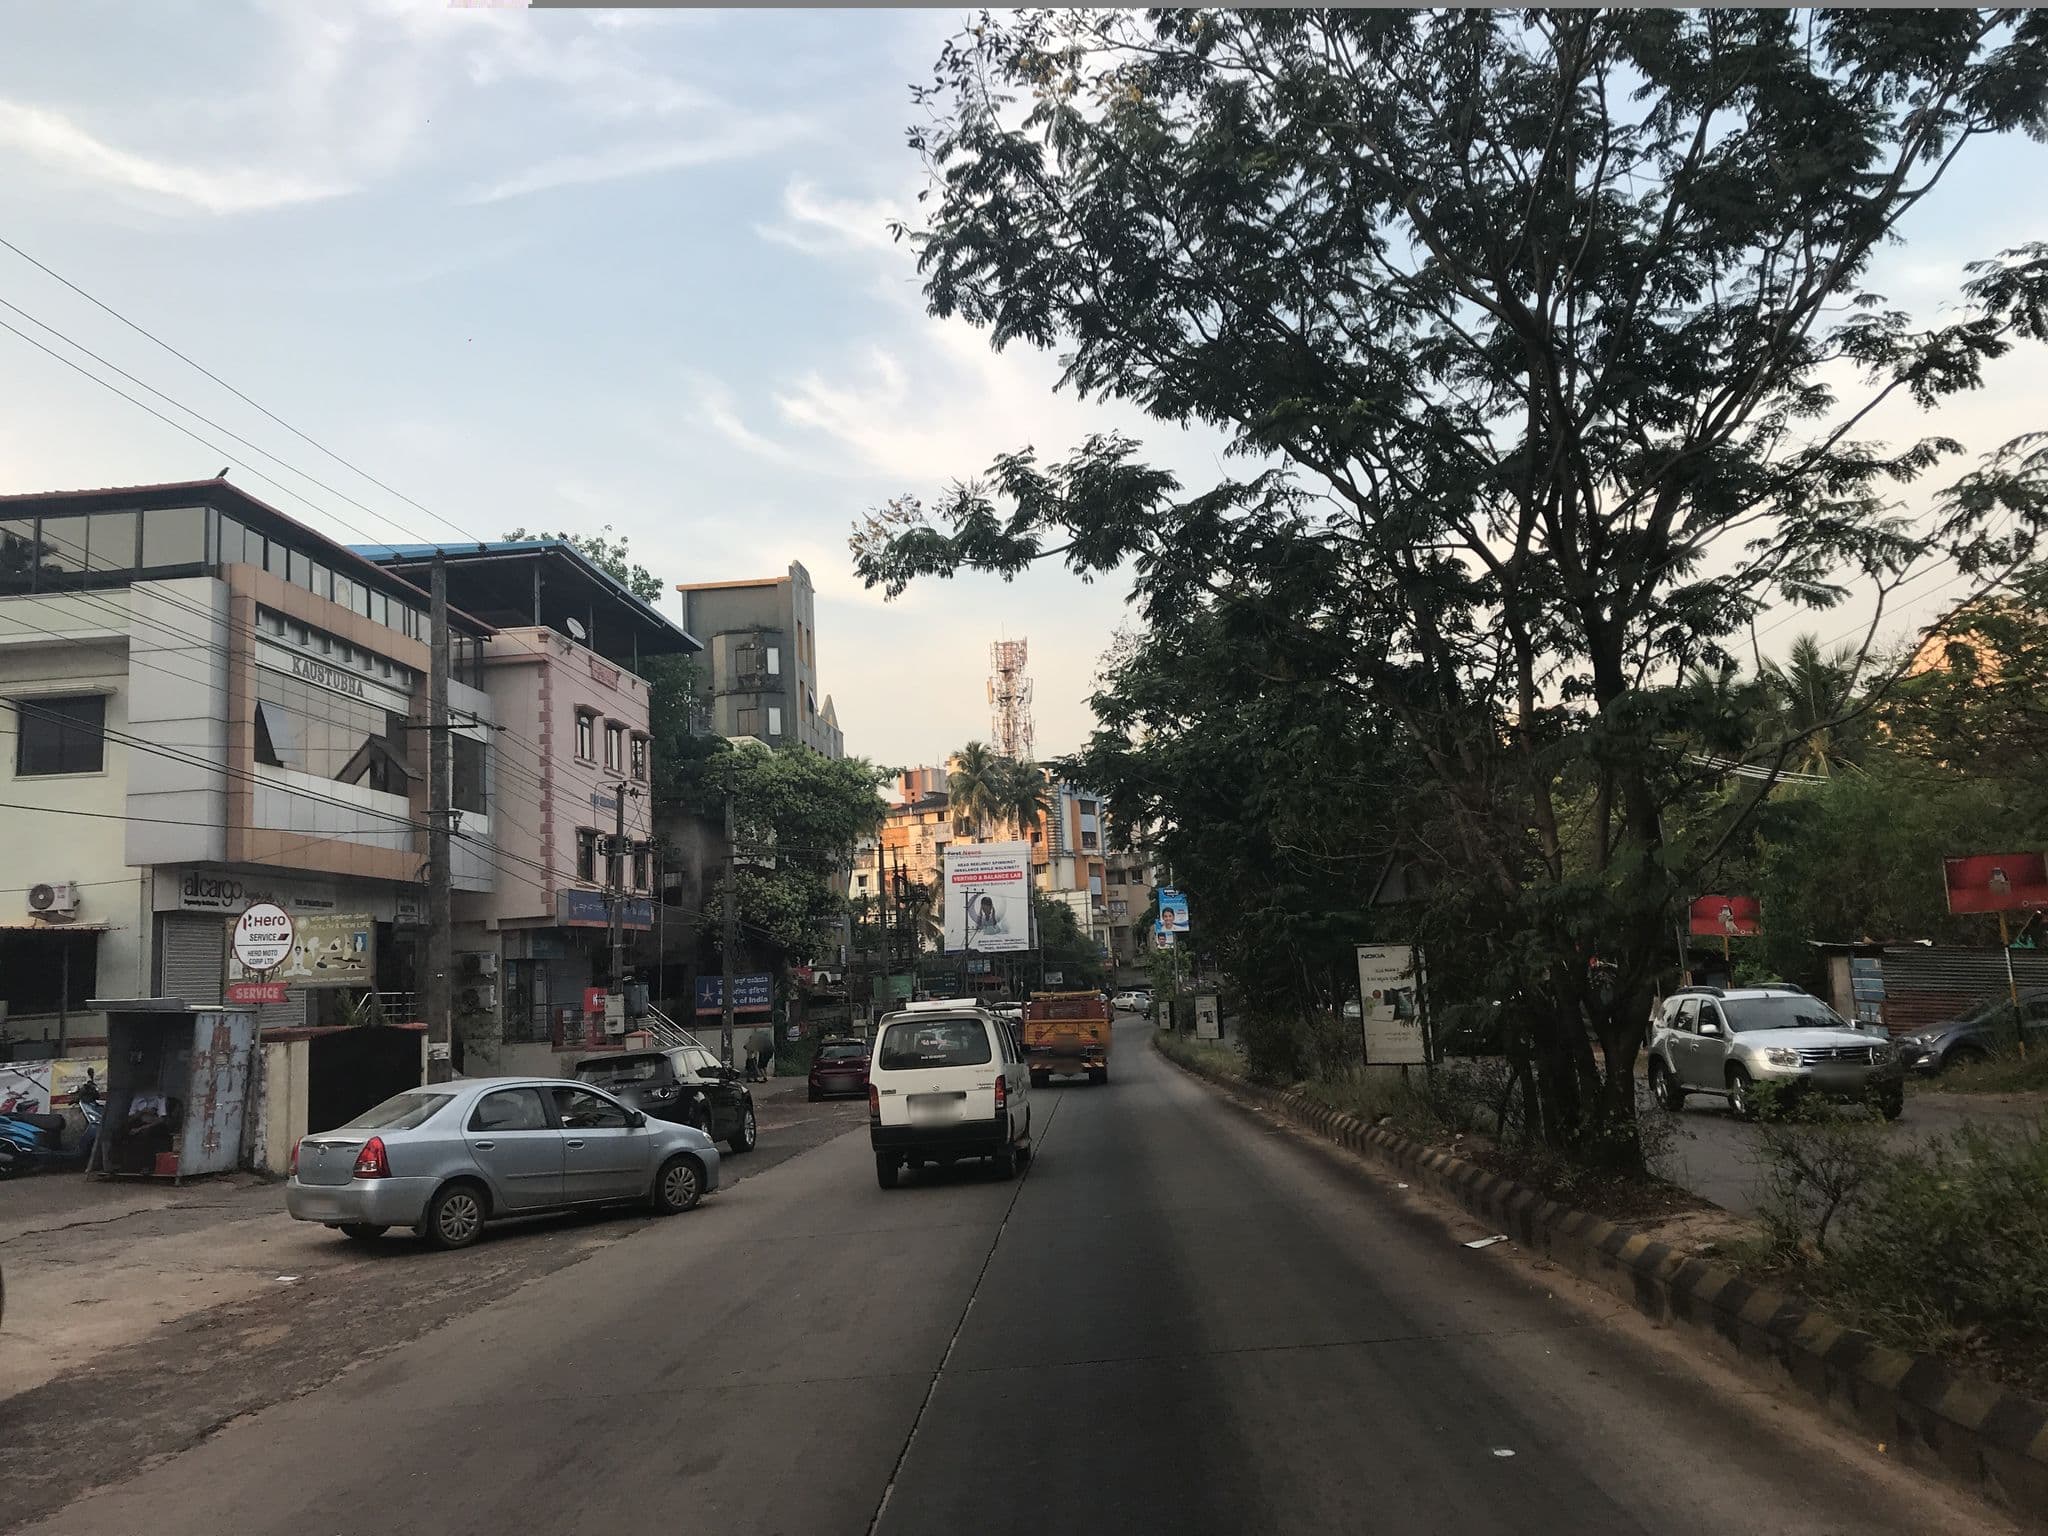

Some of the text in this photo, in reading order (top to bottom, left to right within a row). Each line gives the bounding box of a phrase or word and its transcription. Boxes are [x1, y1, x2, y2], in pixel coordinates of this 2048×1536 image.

[292, 655, 364, 698] KAUSTUBHA
[184, 872, 243, 907] allcargo
[254, 915, 286, 928] Hero
[249, 933, 277, 942] SERVICE
[264, 957, 274, 965] LTD
[236, 987, 279, 1000] SERVICE
[739, 996, 748, 1004] of
[749, 995, 768, 1003] India
